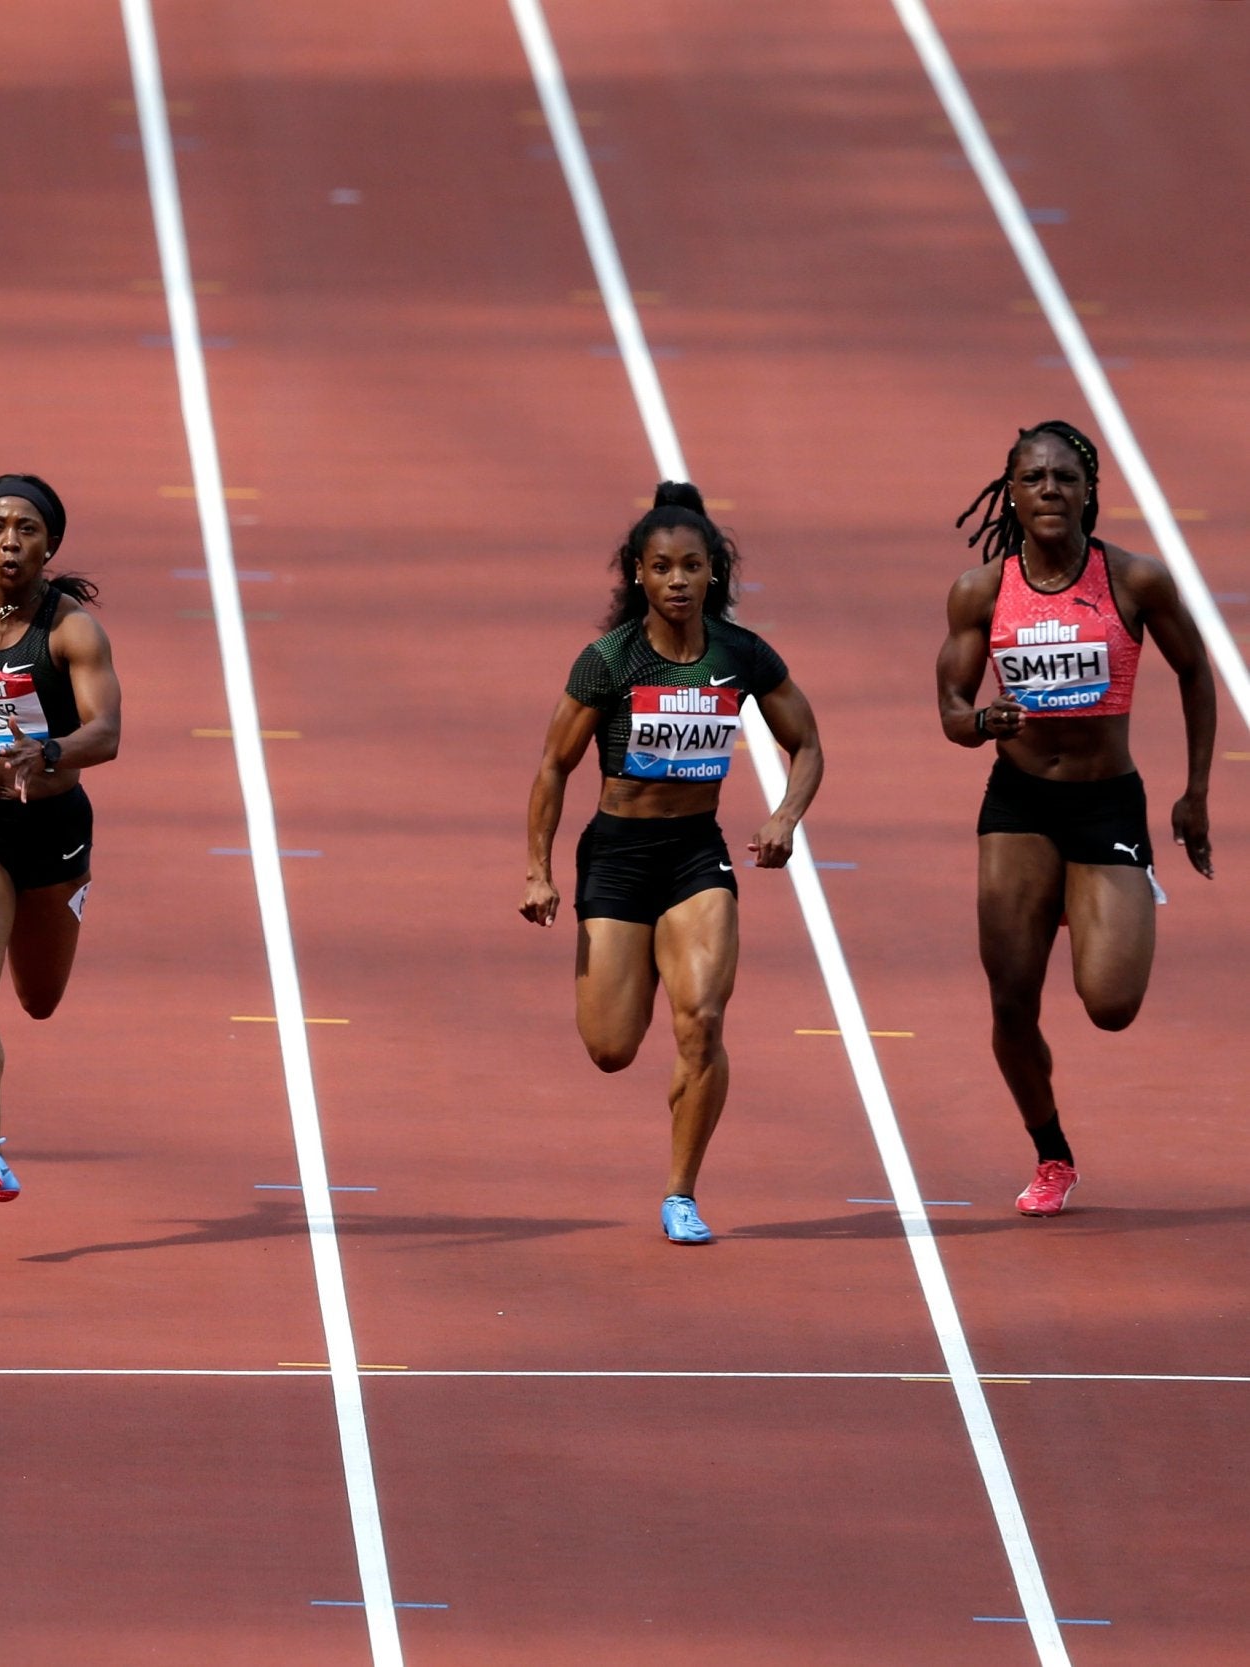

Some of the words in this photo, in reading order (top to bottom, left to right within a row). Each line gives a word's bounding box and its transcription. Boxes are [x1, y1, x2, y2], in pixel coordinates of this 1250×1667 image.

[1017, 619, 1080, 645] müller
[1002, 651, 1100, 682] SMITH
[659, 688, 719, 713] müller
[1037, 691, 1101, 708] London
[637, 723, 736, 751] BRYANT
[666, 763, 721, 777] London
